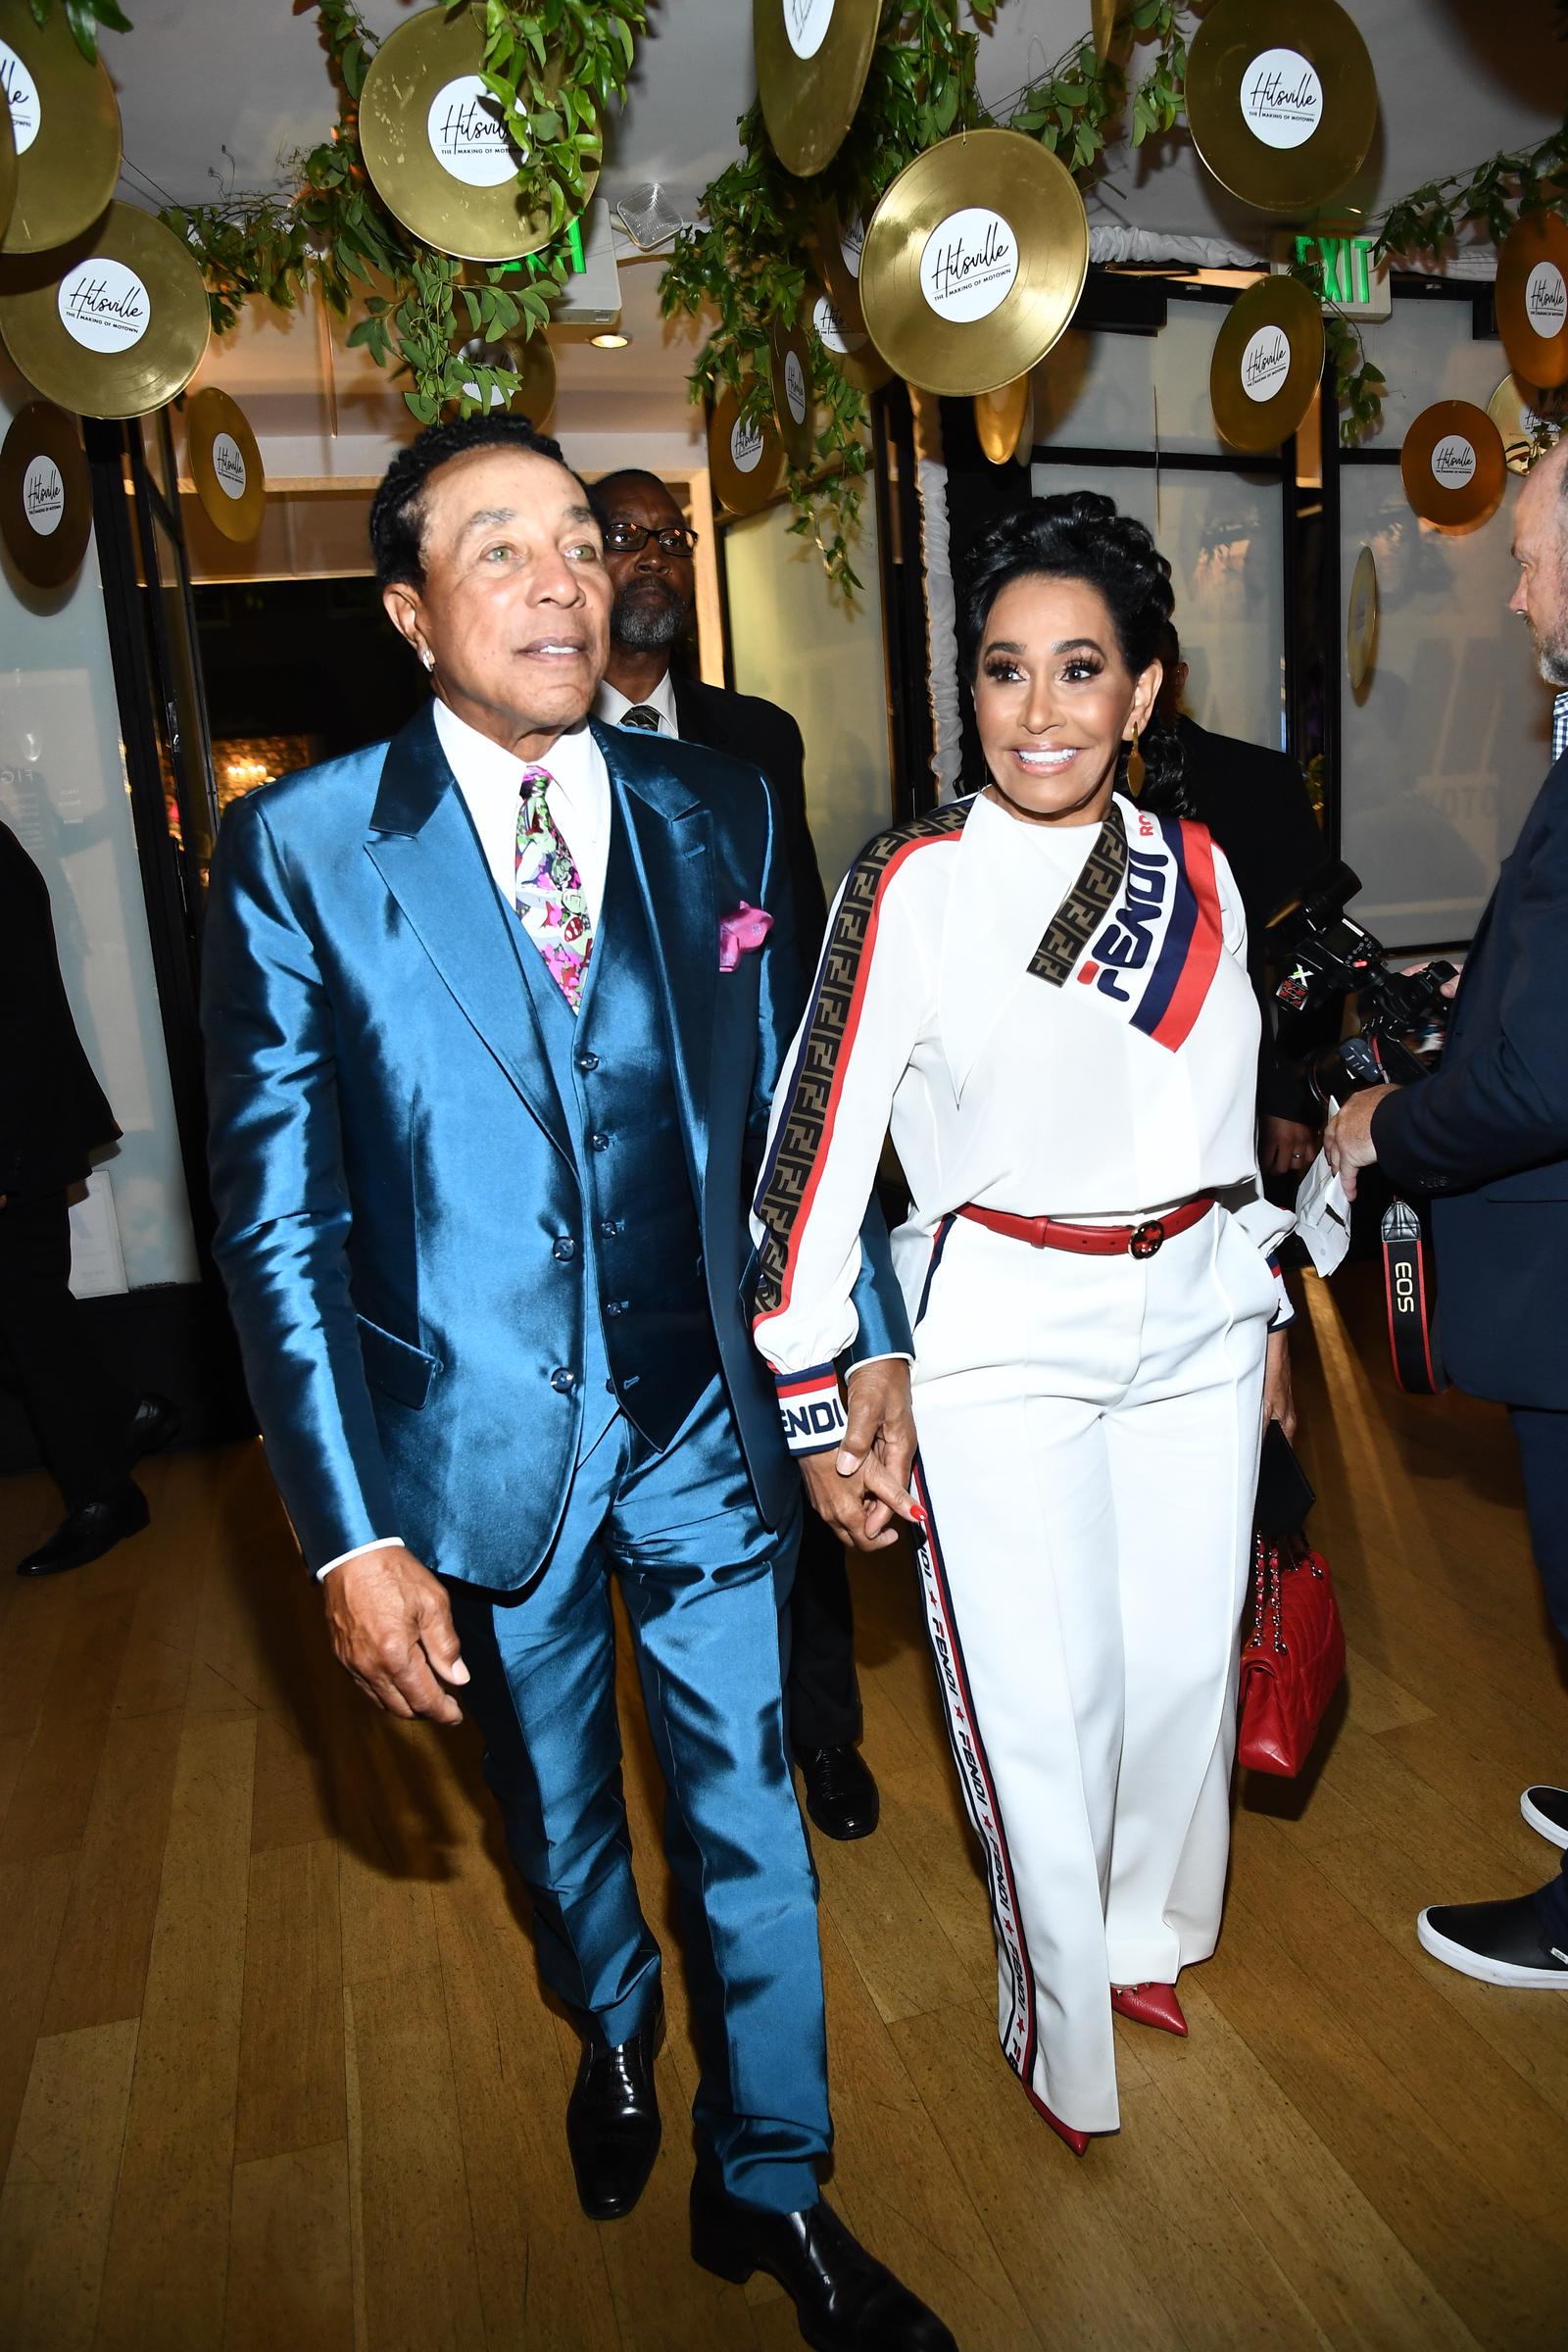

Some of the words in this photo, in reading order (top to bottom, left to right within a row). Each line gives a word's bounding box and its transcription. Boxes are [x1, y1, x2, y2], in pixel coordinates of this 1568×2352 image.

[1250, 72, 1317, 118] Hitsville
[440, 101, 508, 155] Hitsvil
[931, 221, 1009, 298] Hitsville
[949, 283, 973, 296] MAKING
[983, 269, 1011, 282] MOTOWN
[70, 277, 143, 318] Hitsville
[79, 316, 103, 325] MAKING
[113, 323, 139, 334] MOTOWN
[1246, 334, 1287, 385] Hitsville
[1077, 845, 1169, 1003] FENDI
[1395, 1261, 1415, 1313] EOS
[932, 1616, 958, 1696] FENDI
[958, 1730, 988, 1806] FENDI
